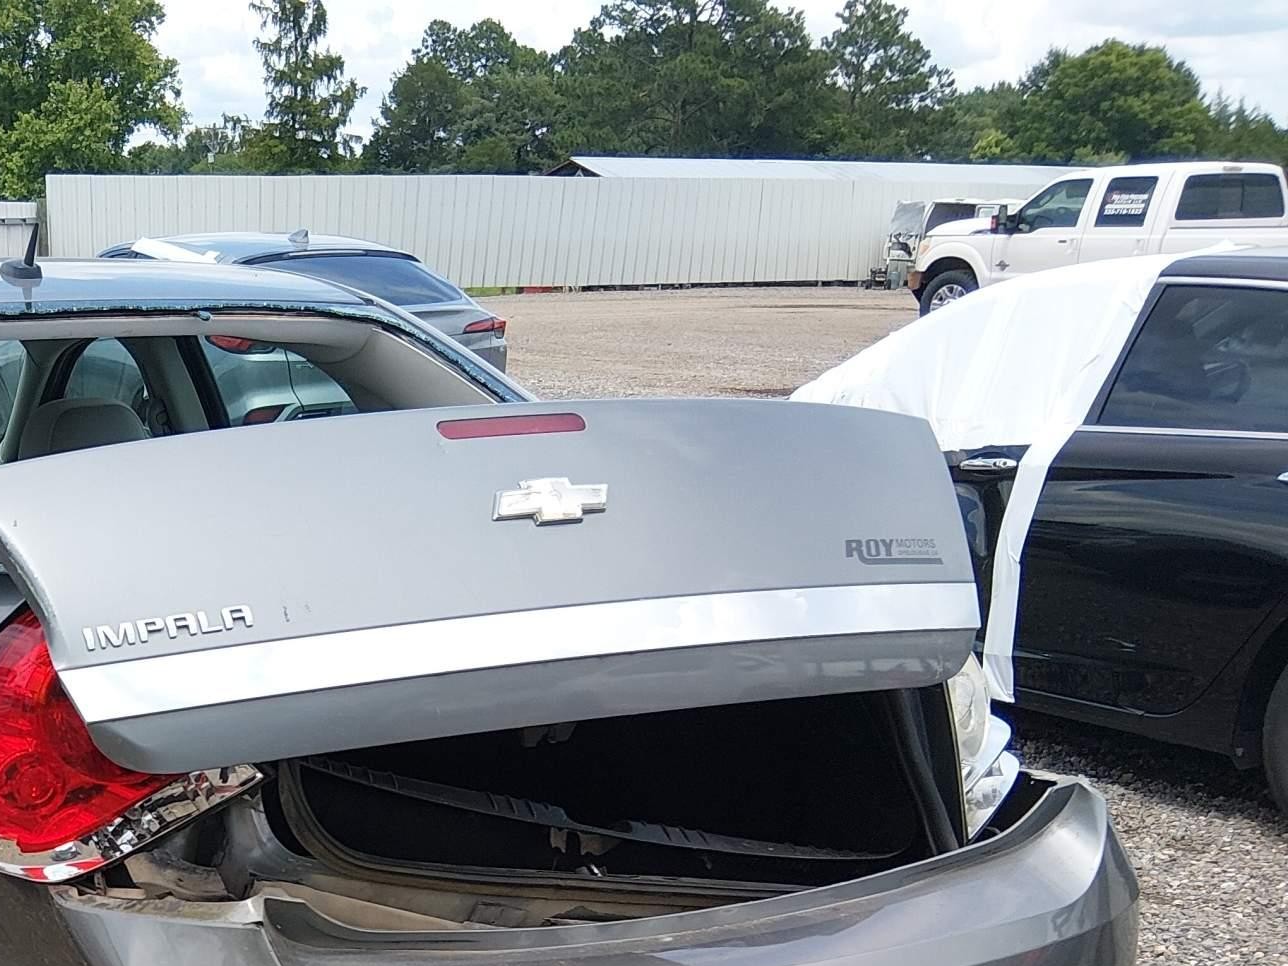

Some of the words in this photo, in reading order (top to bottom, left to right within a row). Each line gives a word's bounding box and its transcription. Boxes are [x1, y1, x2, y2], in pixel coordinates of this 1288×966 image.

[845, 539, 893, 558] ROY
[895, 539, 936, 549] MOTORS
[82, 604, 254, 652] IMPALA
